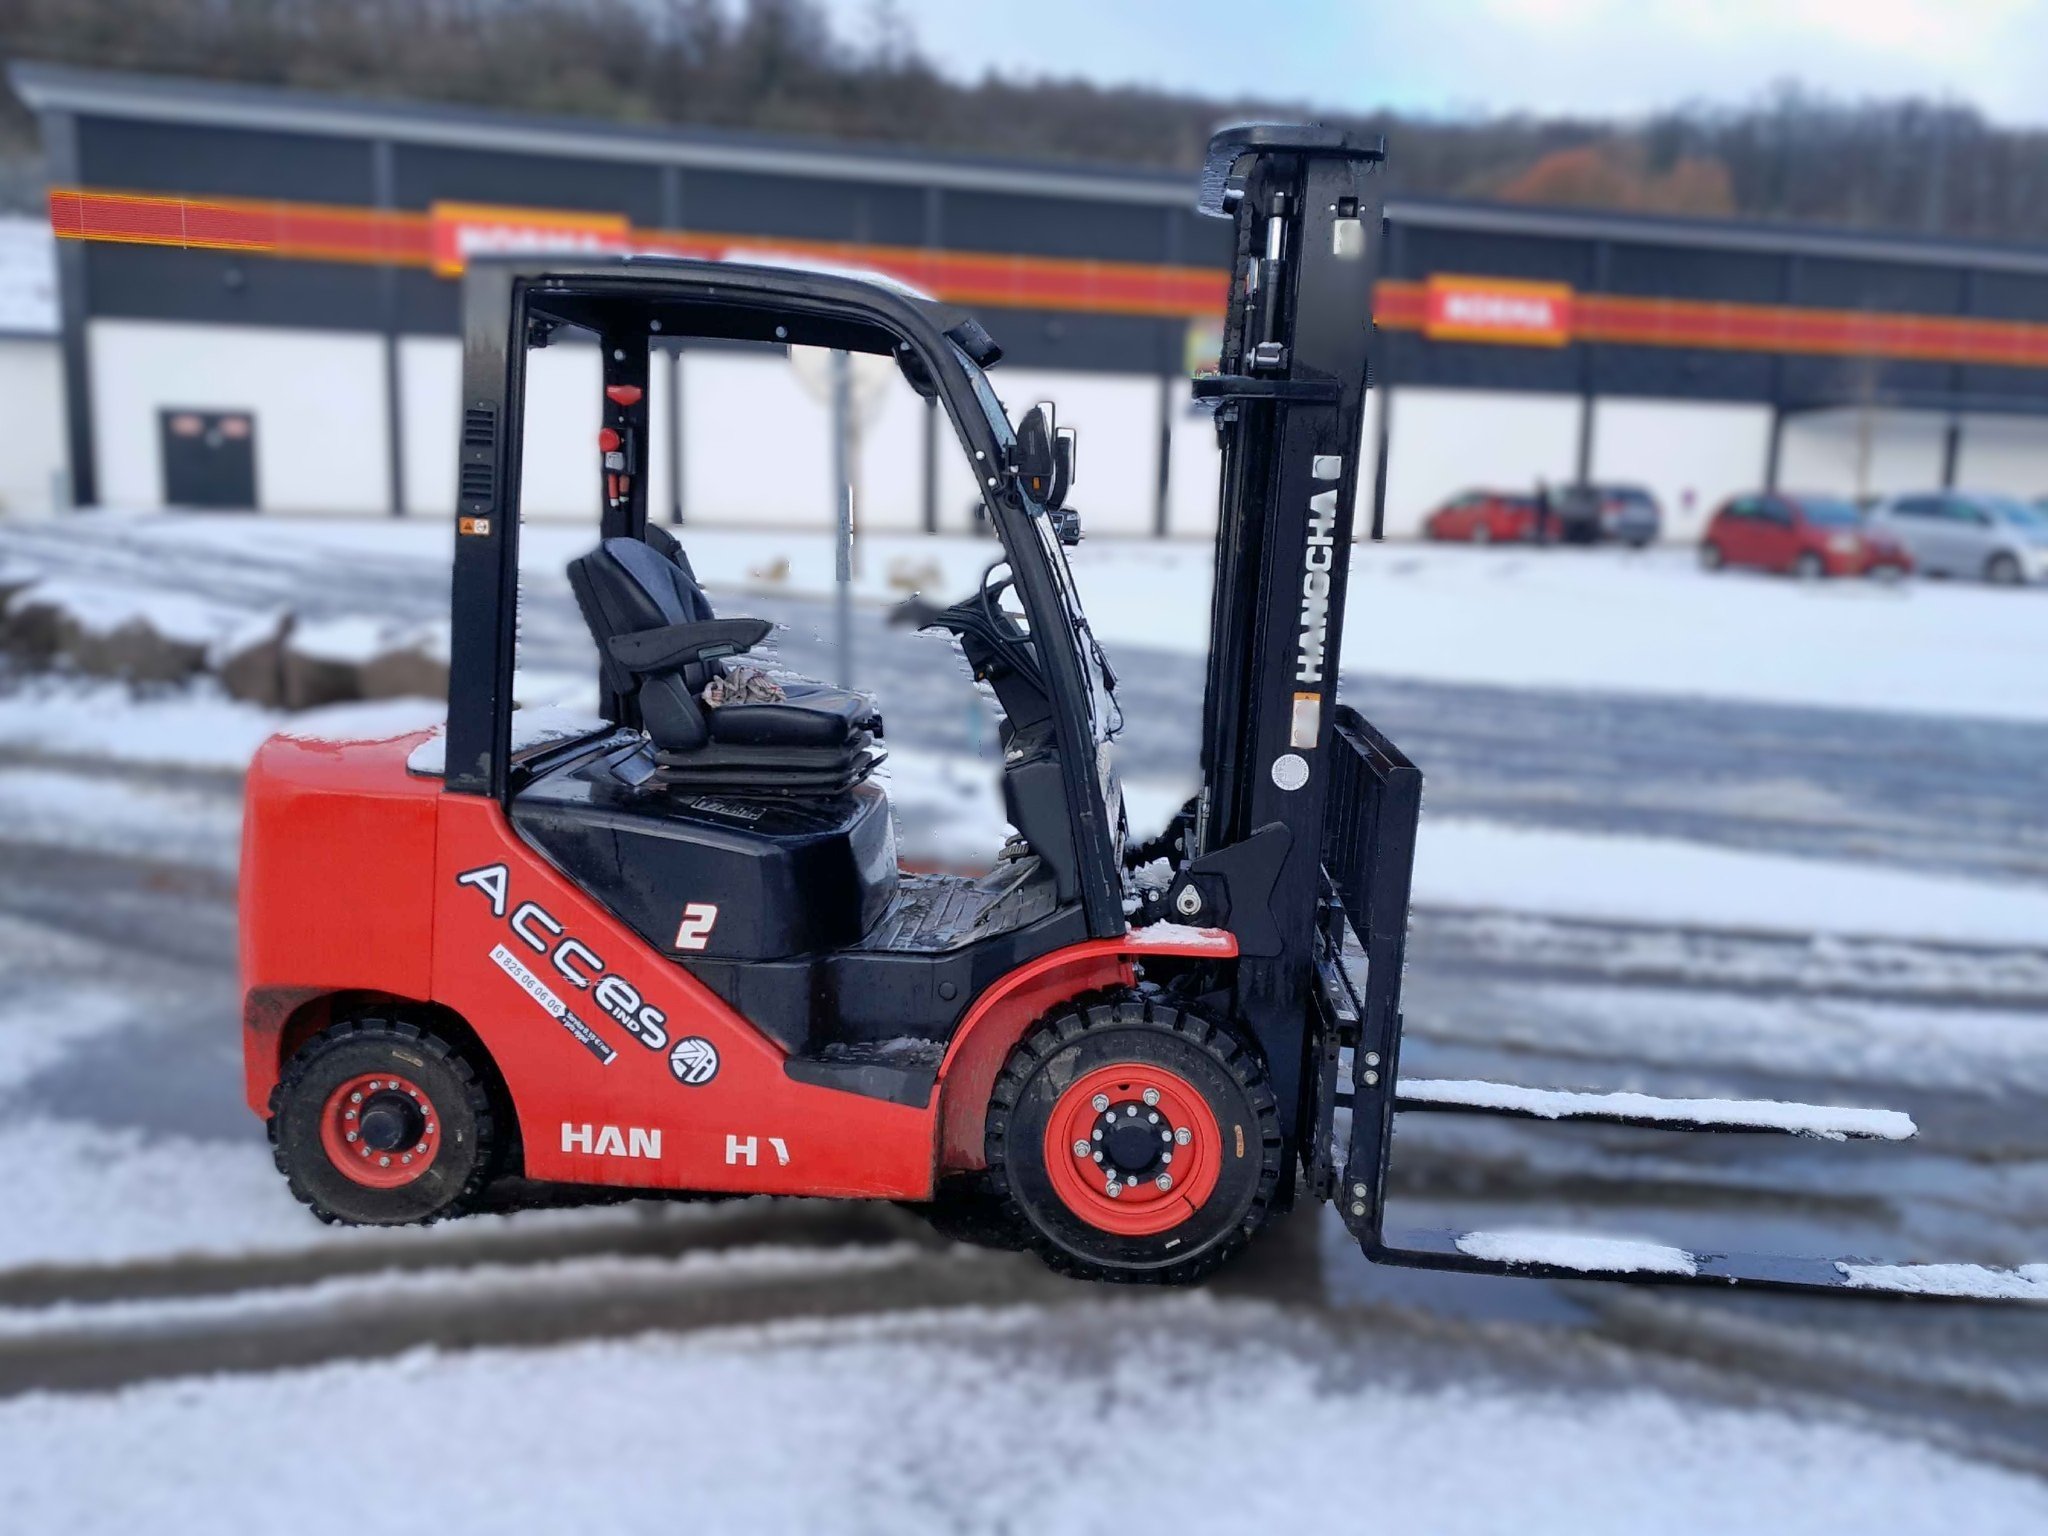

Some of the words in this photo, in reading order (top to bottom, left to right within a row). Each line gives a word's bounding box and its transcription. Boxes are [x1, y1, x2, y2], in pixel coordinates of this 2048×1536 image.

[675, 903, 718, 950] 2
[504, 957, 523, 977] 825
[522, 974, 536, 990] 06
[534, 986, 549, 1002] 06
[547, 999, 562, 1014] 06
[612, 1006, 641, 1032] IND
